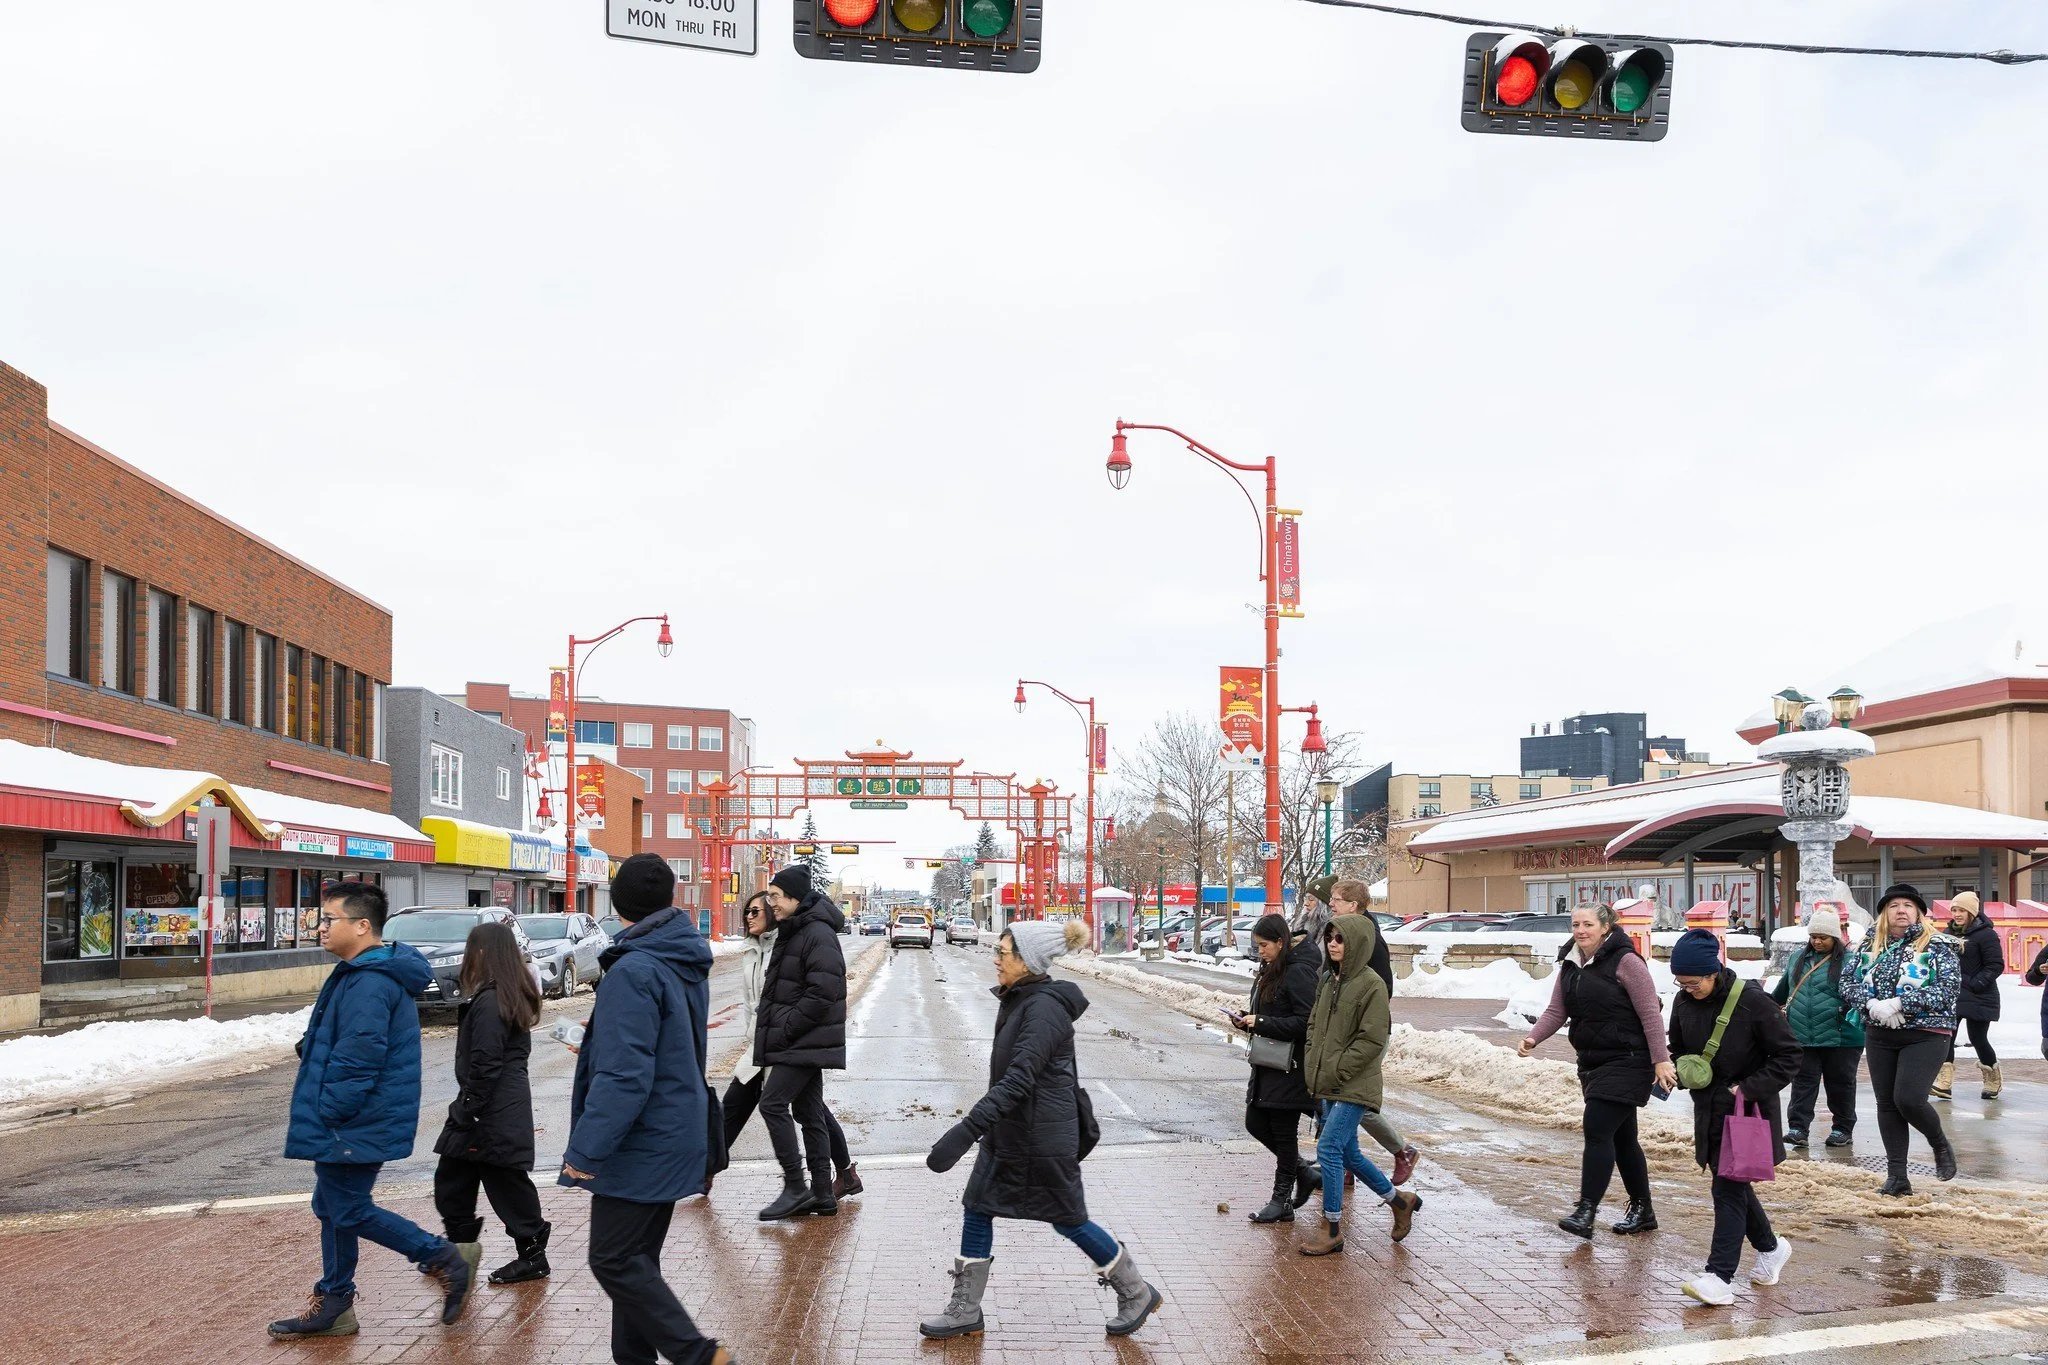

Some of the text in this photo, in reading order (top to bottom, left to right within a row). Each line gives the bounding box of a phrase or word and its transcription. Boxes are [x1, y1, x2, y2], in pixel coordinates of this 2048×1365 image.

[627, 8, 736, 39] MON THRU FRI
[1283, 517, 1293, 573] Chinatown
[300, 832, 317, 843] SUDAN
[318, 835, 339, 847] SUPPLIES
[360, 841, 387, 852] COLLECTION
[552, 853, 566, 871] VIE
[1513, 848, 1558, 871] LUCKY
[147, 894, 166, 904] OPEN
